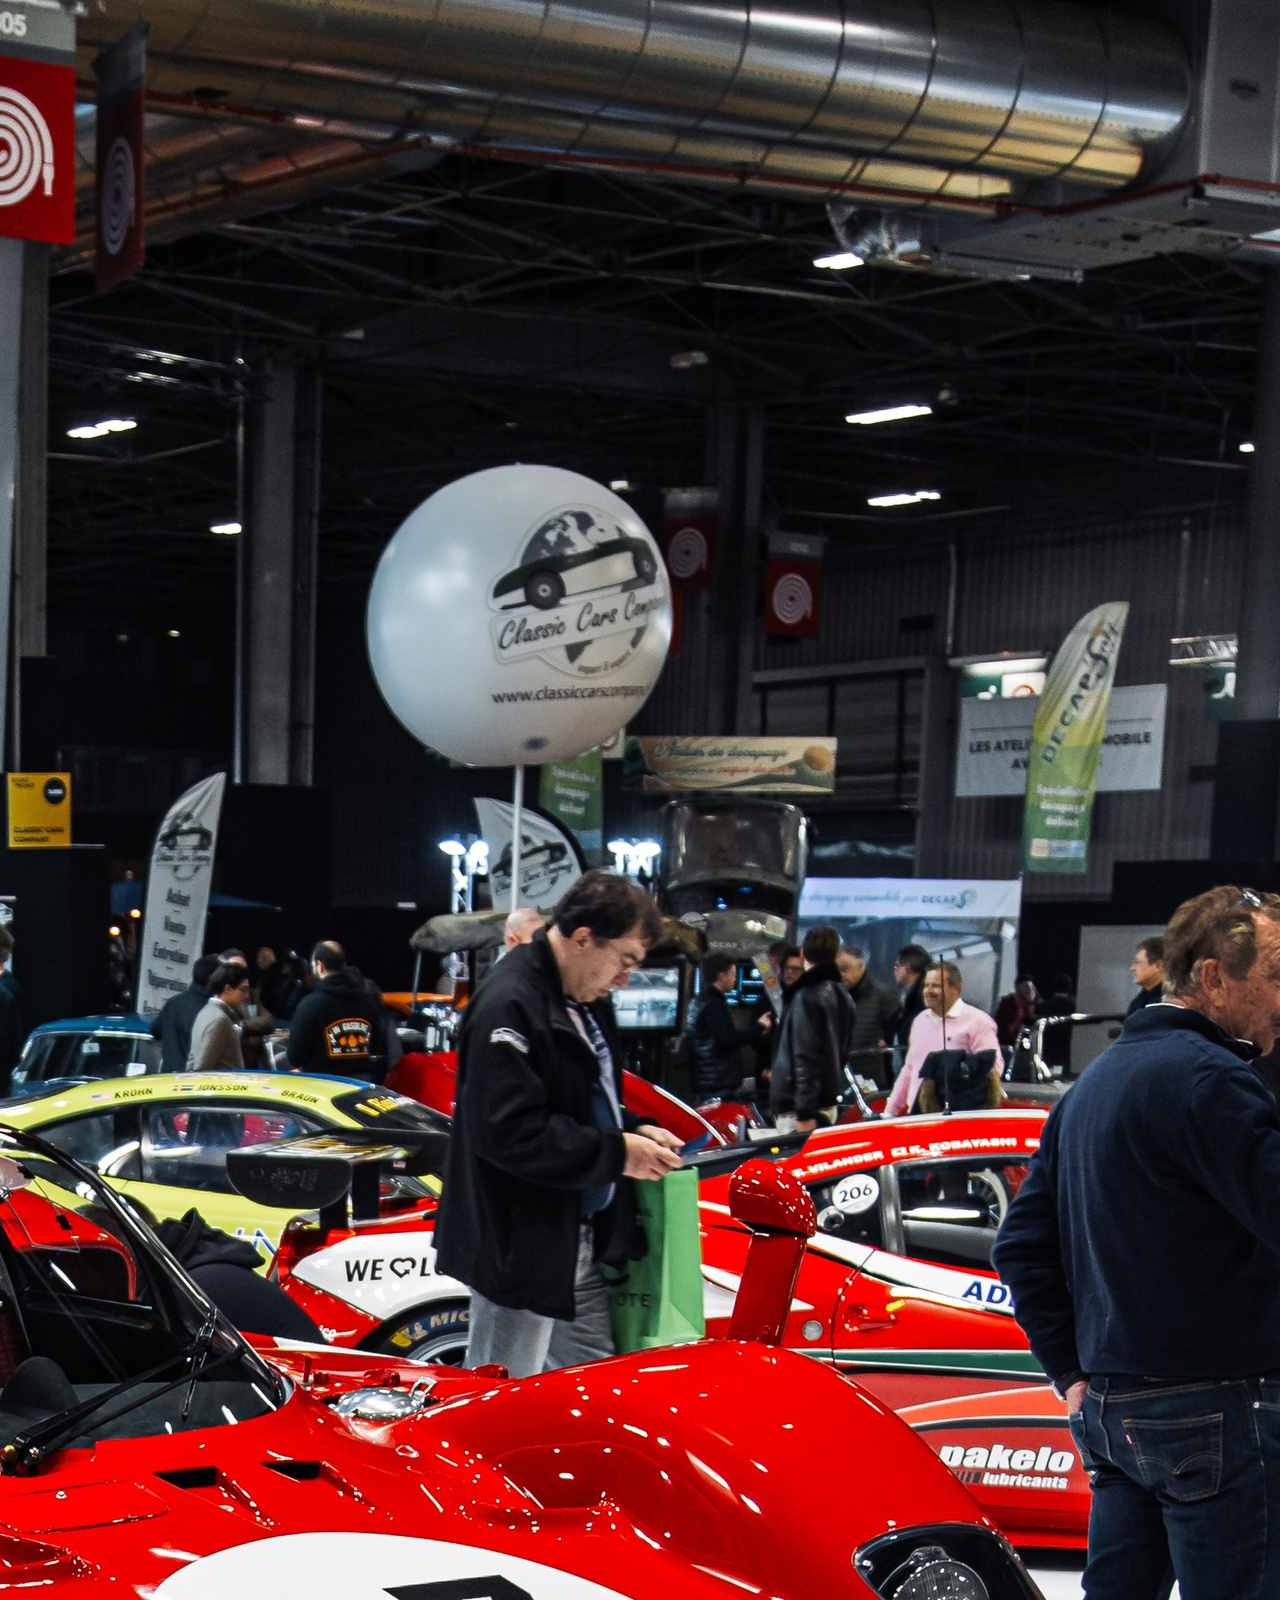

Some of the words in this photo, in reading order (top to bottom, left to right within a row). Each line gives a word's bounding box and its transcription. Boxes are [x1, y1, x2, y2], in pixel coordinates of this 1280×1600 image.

[498, 616, 567, 650] Classic
[575, 601, 619, 632] Cars
[968, 740, 991, 754] LES
[113, 1087, 153, 1100] KROHN
[280, 1088, 322, 1105] BRAUN
[807, 1150, 885, 1176] VILANDER
[928, 1137, 1017, 1152] KOBAYASHI
[839, 1182, 874, 1204] 206
[344, 1258, 385, 1283] WE
[938, 1443, 1076, 1473] pakelo
[982, 1471, 1069, 1490] lubricants
